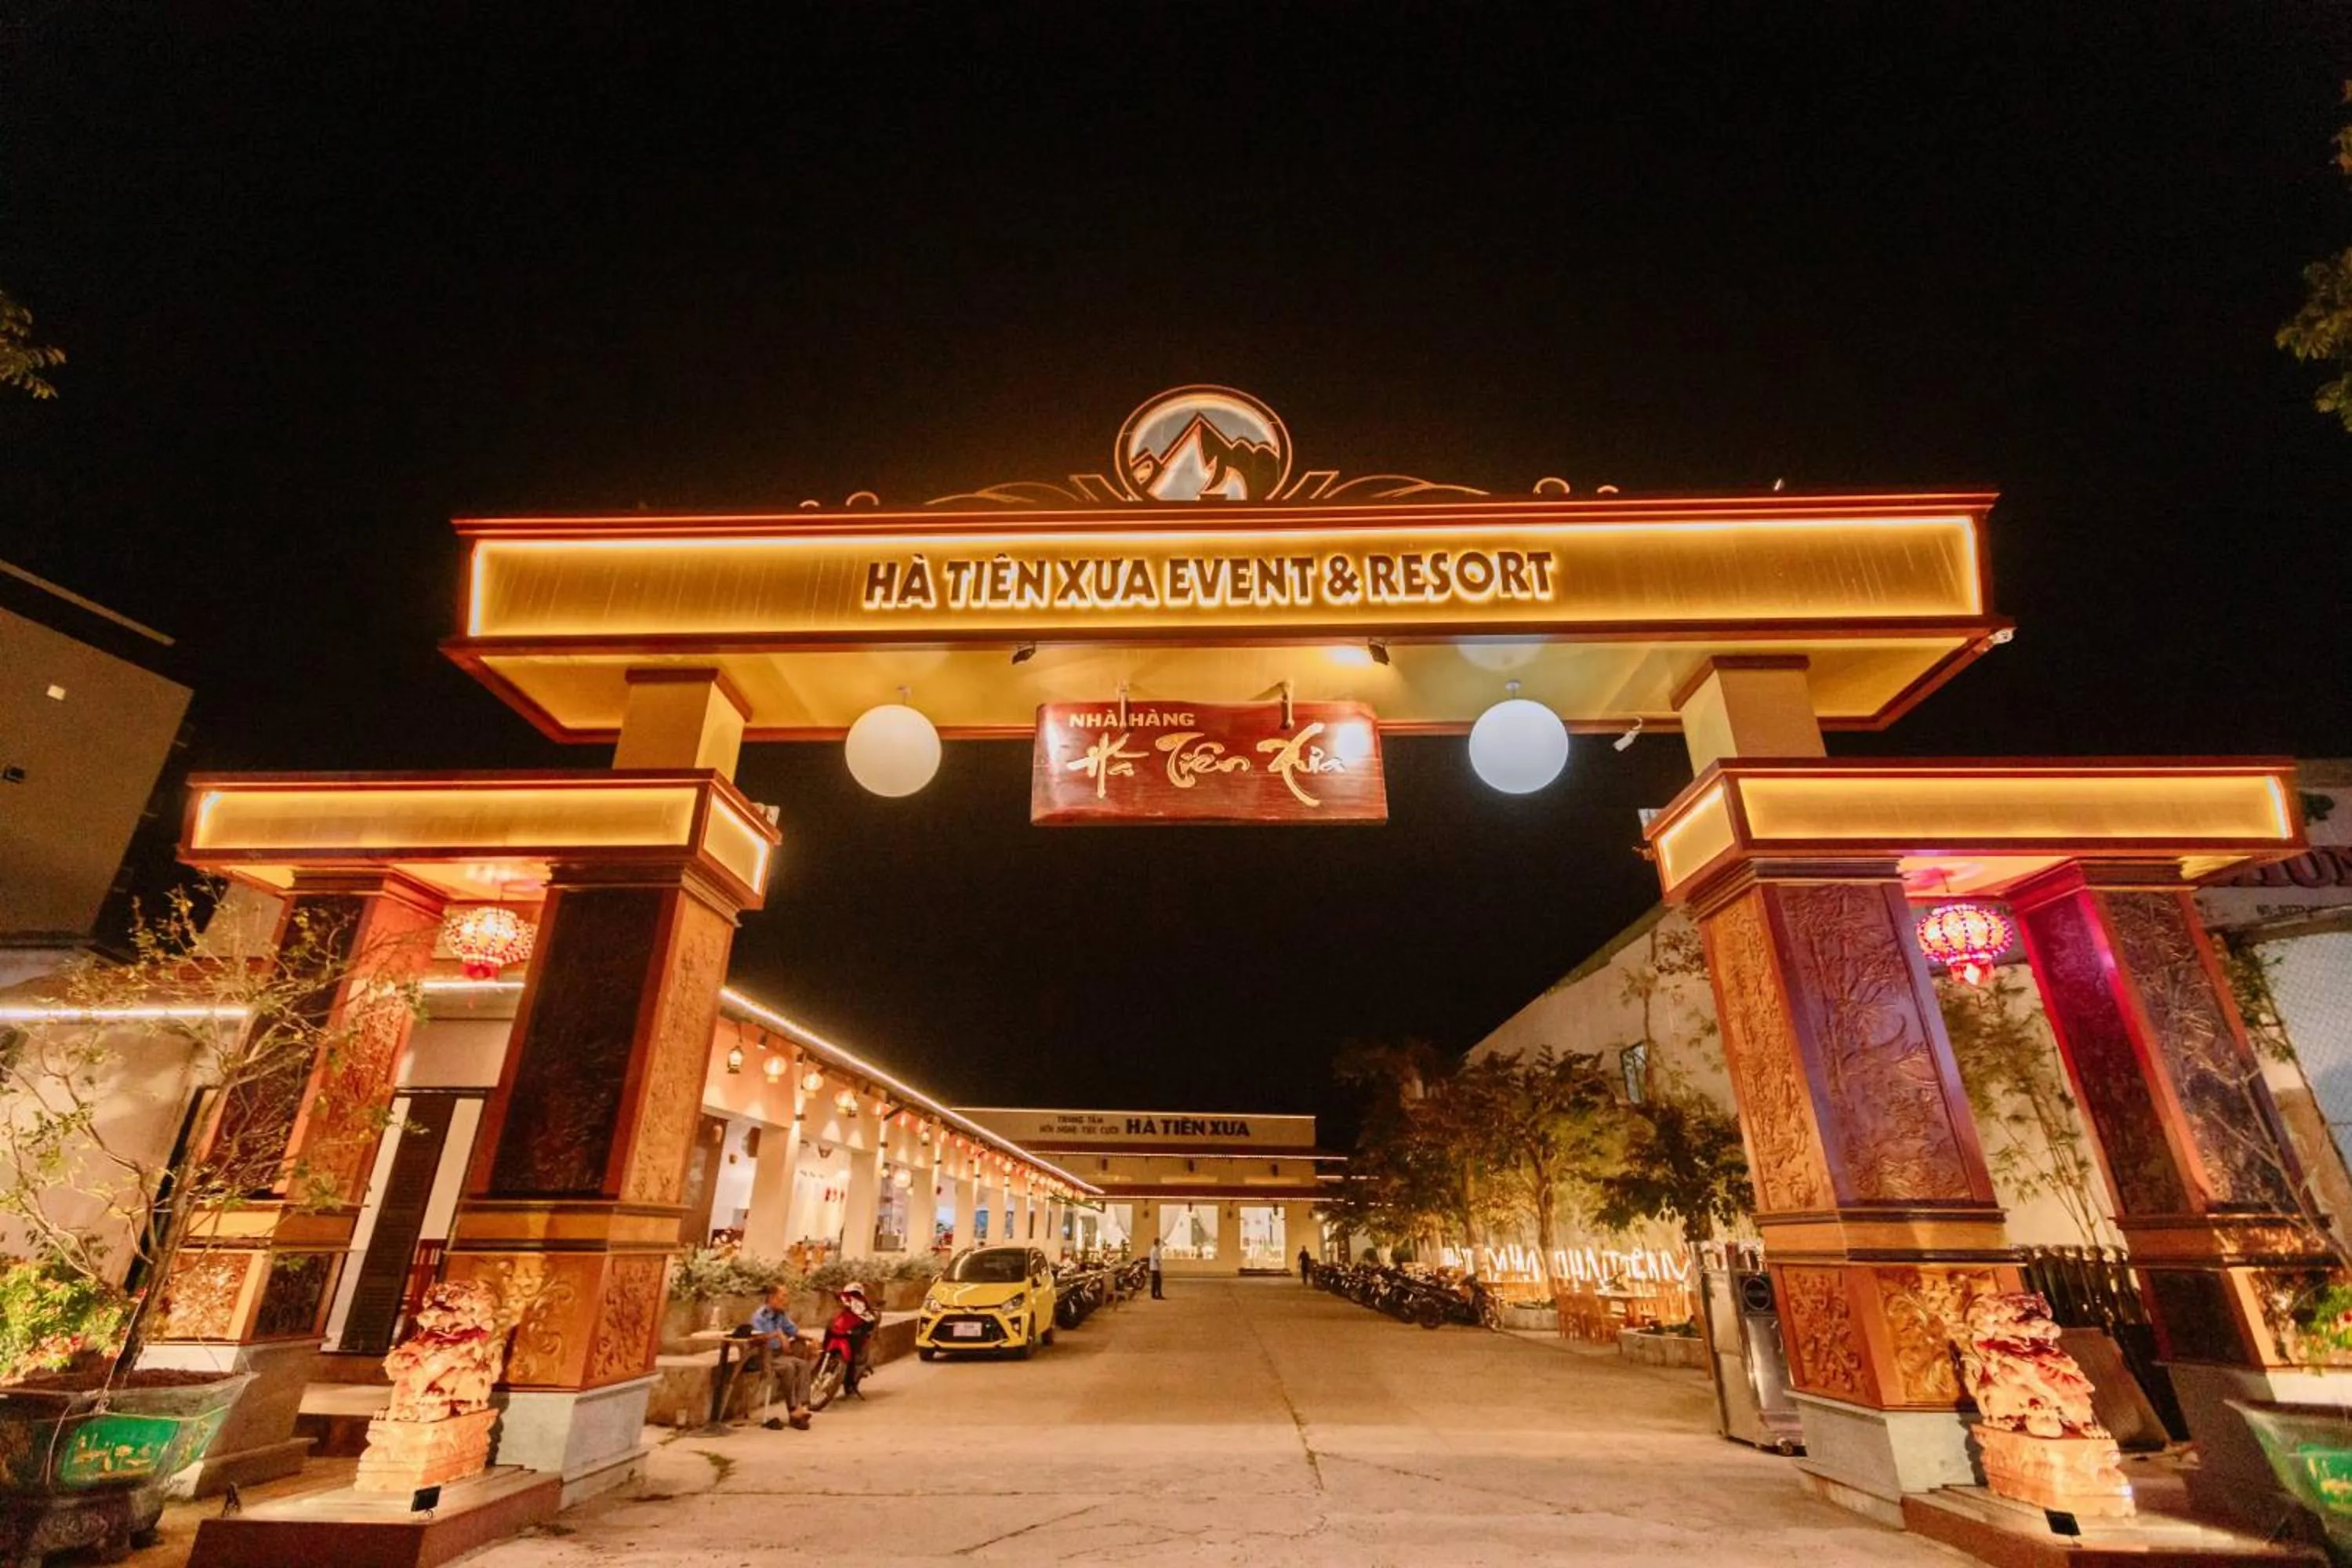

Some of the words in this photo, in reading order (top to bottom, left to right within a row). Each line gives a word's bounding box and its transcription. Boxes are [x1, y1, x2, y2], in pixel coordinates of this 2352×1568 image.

[865, 554, 934, 604] HÀ
[946, 554, 1047, 604] TIÊN
[1168, 557, 1314, 601] EVENT
[1327, 555, 1360, 599] &
[1368, 551, 1552, 599] RESORT
[1069, 710, 1118, 728] NHÀ
[1130, 709, 1195, 727] HÀNG
[1156, 732, 1250, 788] Tiên
[1127, 1116, 1156, 1134] HÀ
[1160, 1116, 1205, 1135] TIÊN
